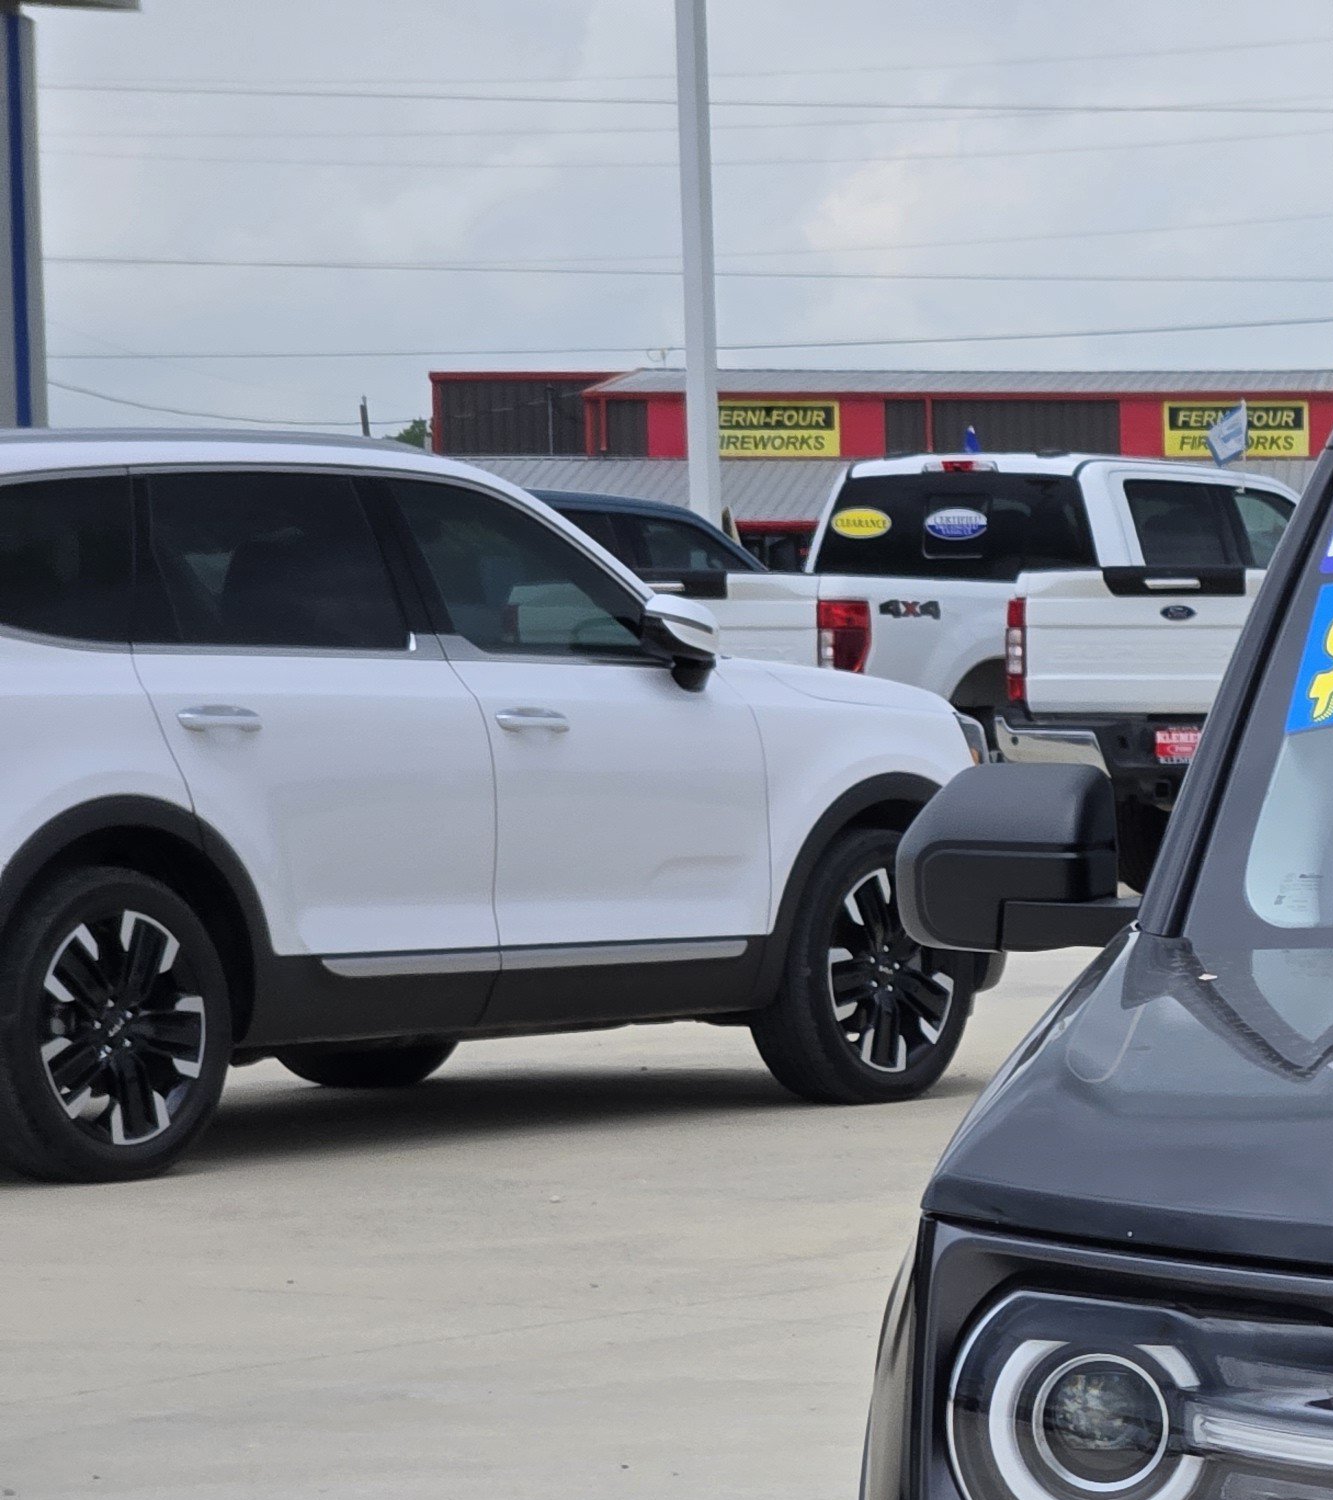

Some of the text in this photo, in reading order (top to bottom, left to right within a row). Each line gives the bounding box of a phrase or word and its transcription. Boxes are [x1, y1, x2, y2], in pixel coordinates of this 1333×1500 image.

[719, 409, 826, 427] ERNI-FOUR
[1177, 409, 1295, 427] FERNFOUR
[719, 434, 826, 451] IREWORKS
[1180, 435, 1295, 451] FIRORKS
[834, 517, 887, 530] CLEARANCE
